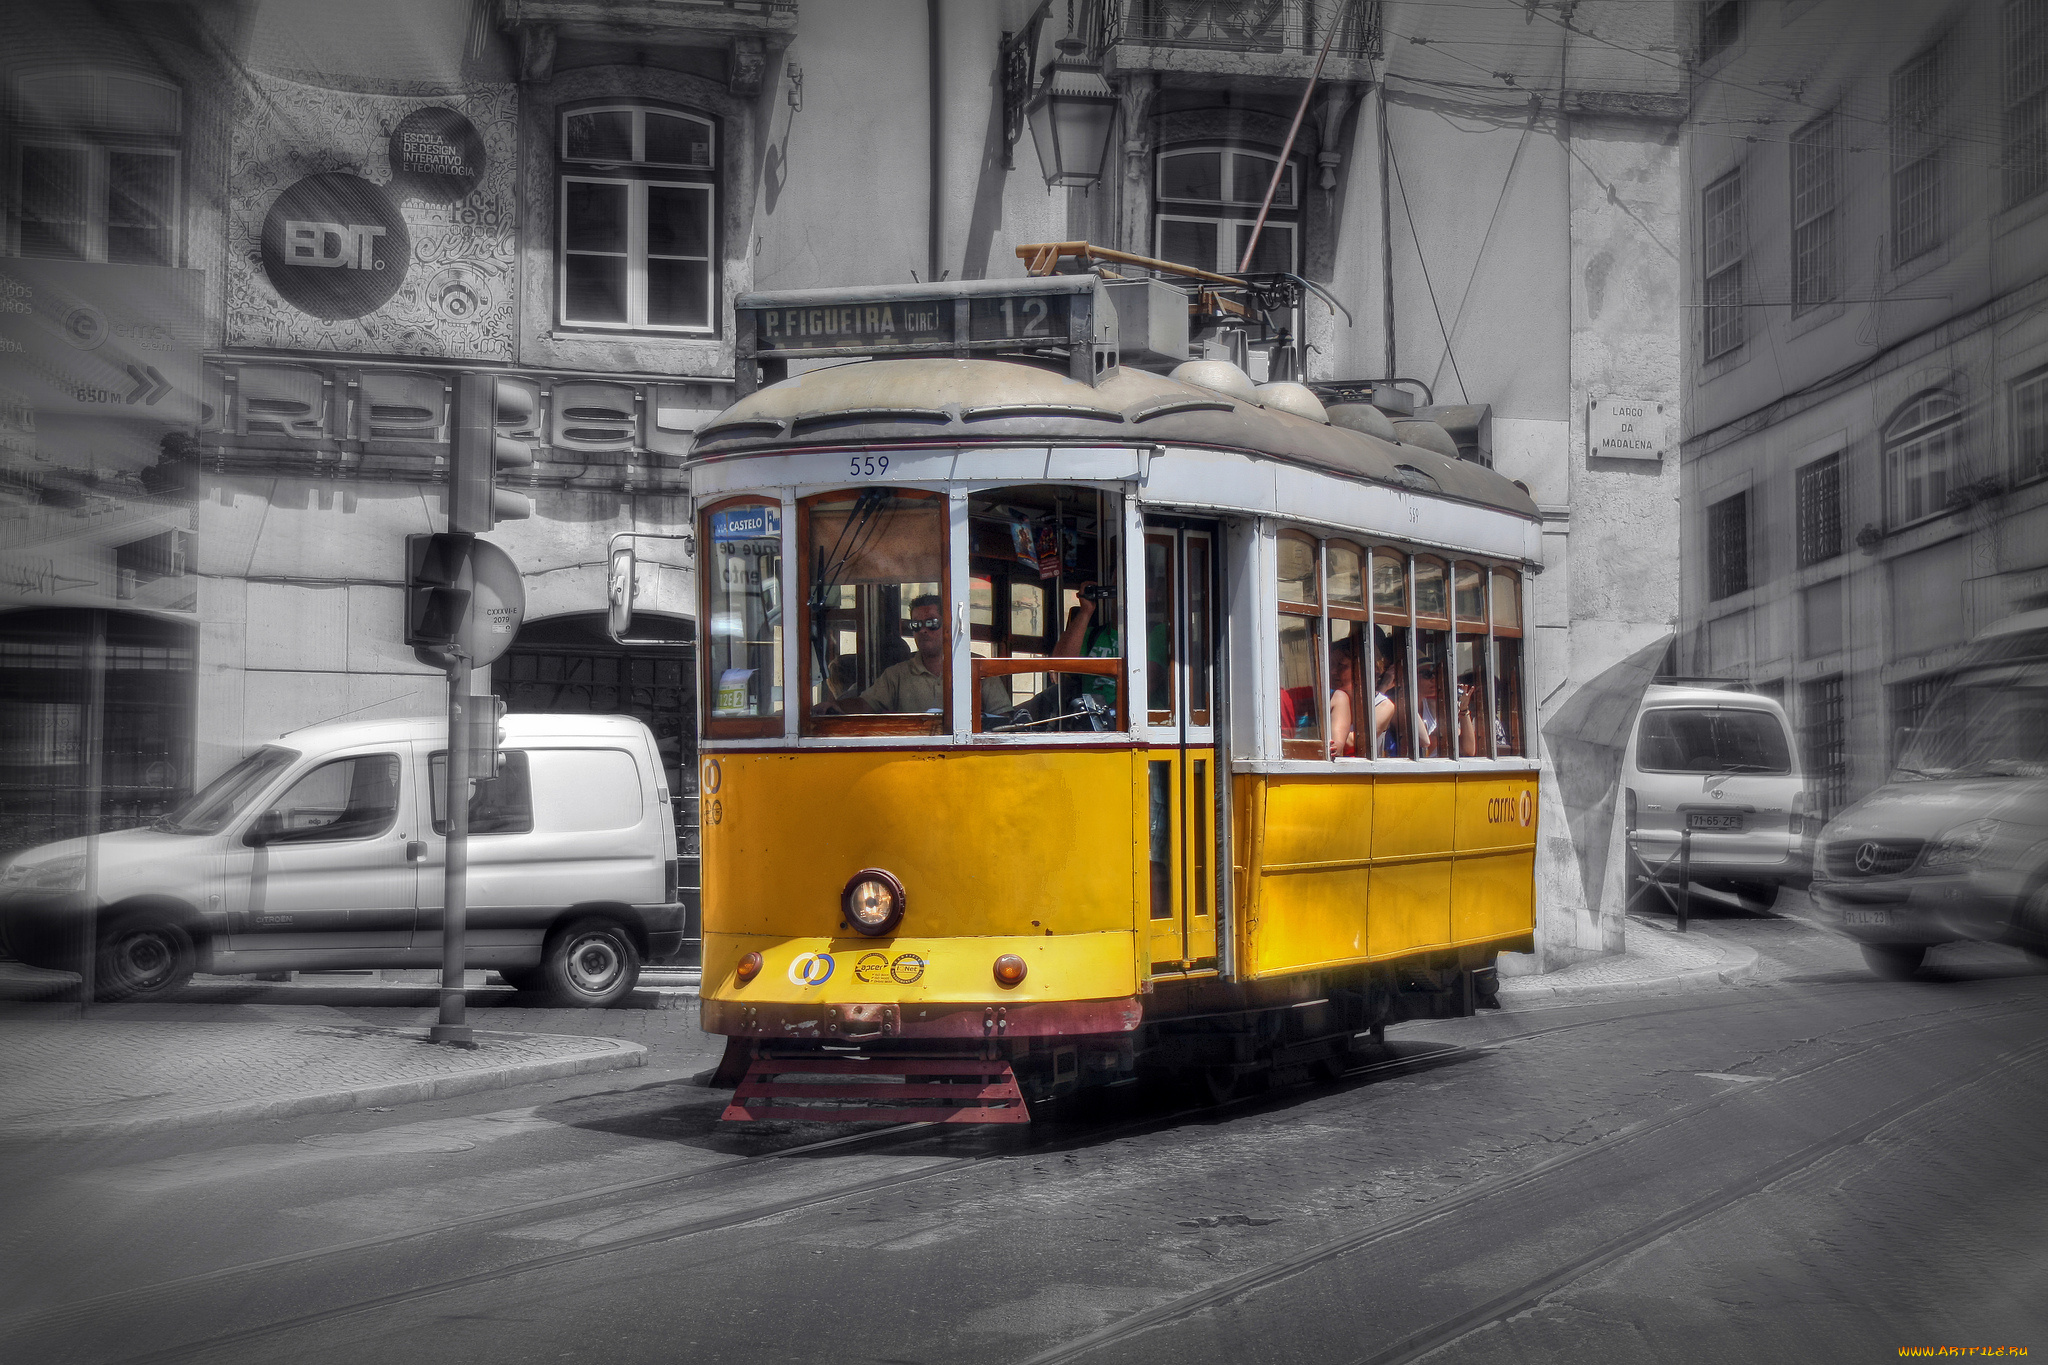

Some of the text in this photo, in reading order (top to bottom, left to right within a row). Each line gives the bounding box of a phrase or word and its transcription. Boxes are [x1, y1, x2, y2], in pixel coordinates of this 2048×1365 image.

[403, 133, 443, 144] ESCOLA
[403, 143, 456, 155] DE DESIGN
[403, 153, 462, 166] INTERATIVO
[403, 162, 475, 176] E TECNOLOGIA
[766, 311, 779, 336] P.
[786, 306, 895, 336] FIGUEIRA
[1000, 298, 1050, 337] 12
[115, 321, 175, 340] emel
[76, 389, 107, 403] 650
[1612, 407, 1643, 417] LARGO
[1621, 423, 1633, 432] DA
[1602, 438, 1653, 449] MADALENA
[850, 456, 889, 476] 559
[729, 517, 763, 531] CASTELO
[493, 616, 510, 624] 2079
[735, 692, 742, 705] 2
[1488, 797, 1515, 823] carris
[861, 964, 884, 972] apcer
